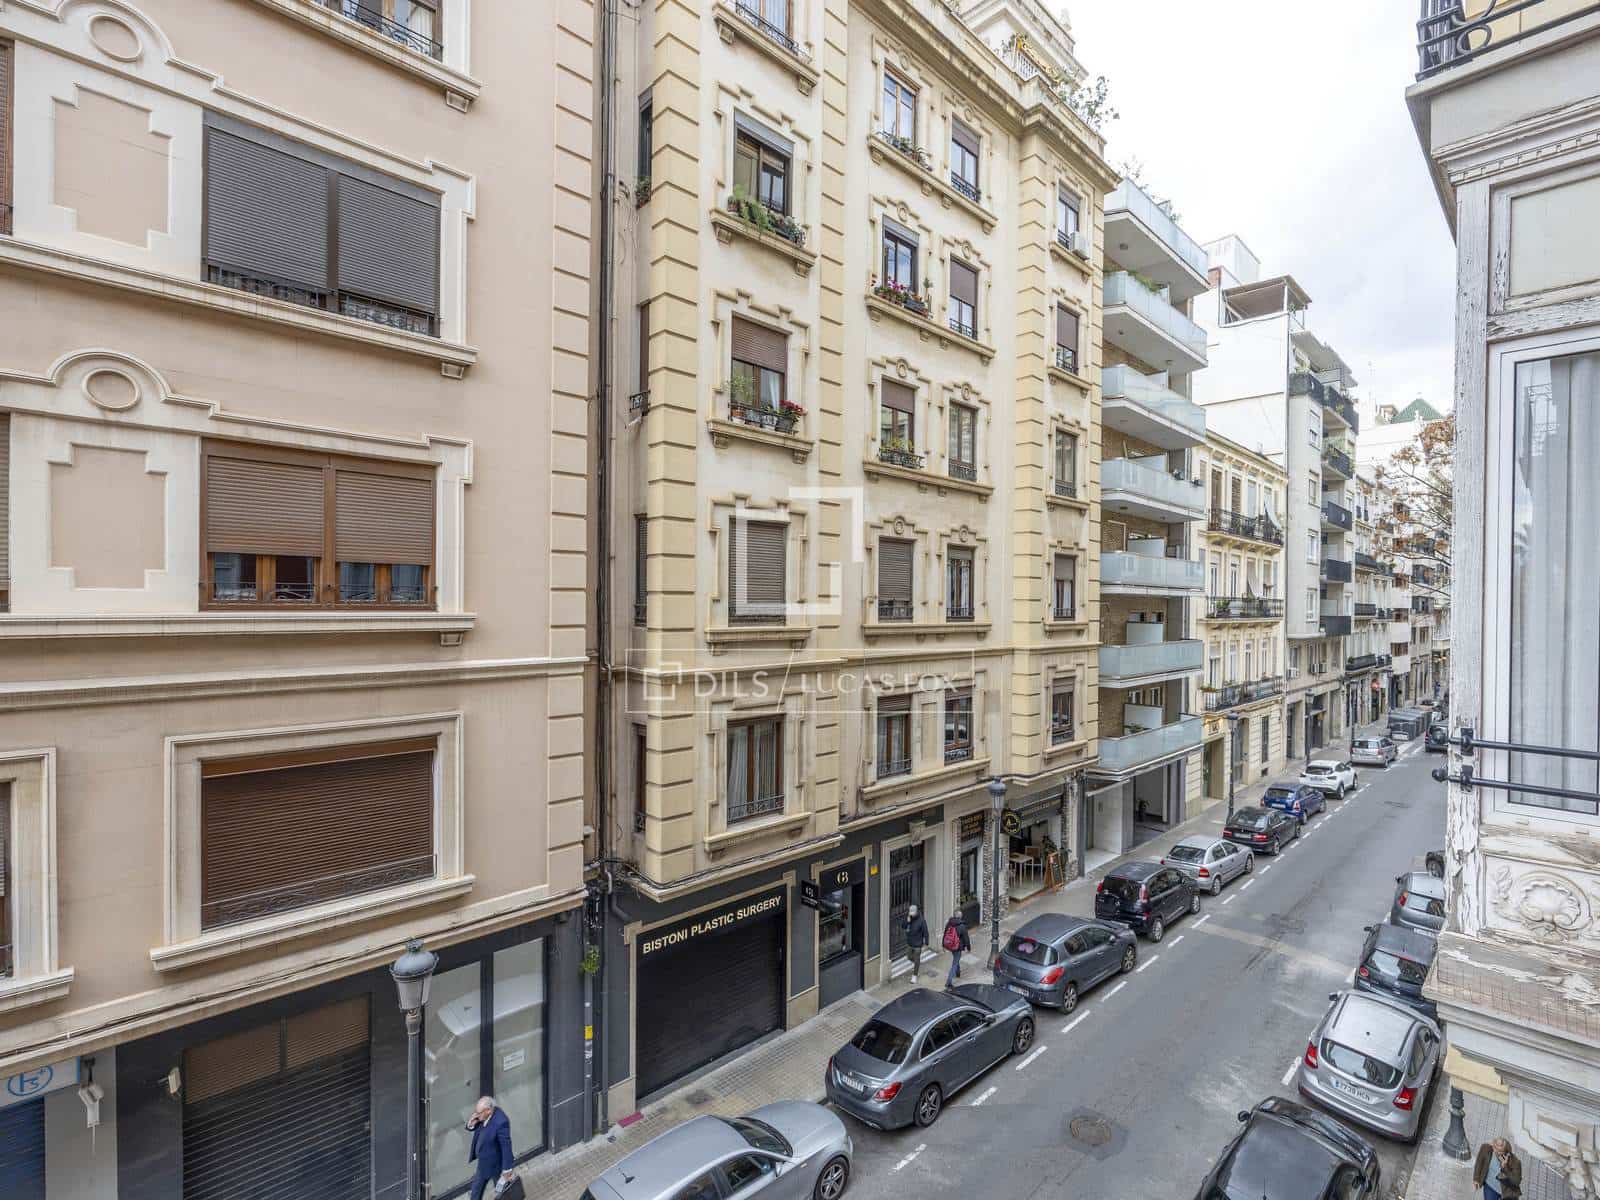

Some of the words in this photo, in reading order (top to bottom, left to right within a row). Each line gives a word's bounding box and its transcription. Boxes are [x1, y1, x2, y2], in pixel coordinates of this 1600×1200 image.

[642, 928, 688, 954] BISTONI
[691, 913, 734, 937] PLASTIC
[736, 896, 781, 920] SURGERY
